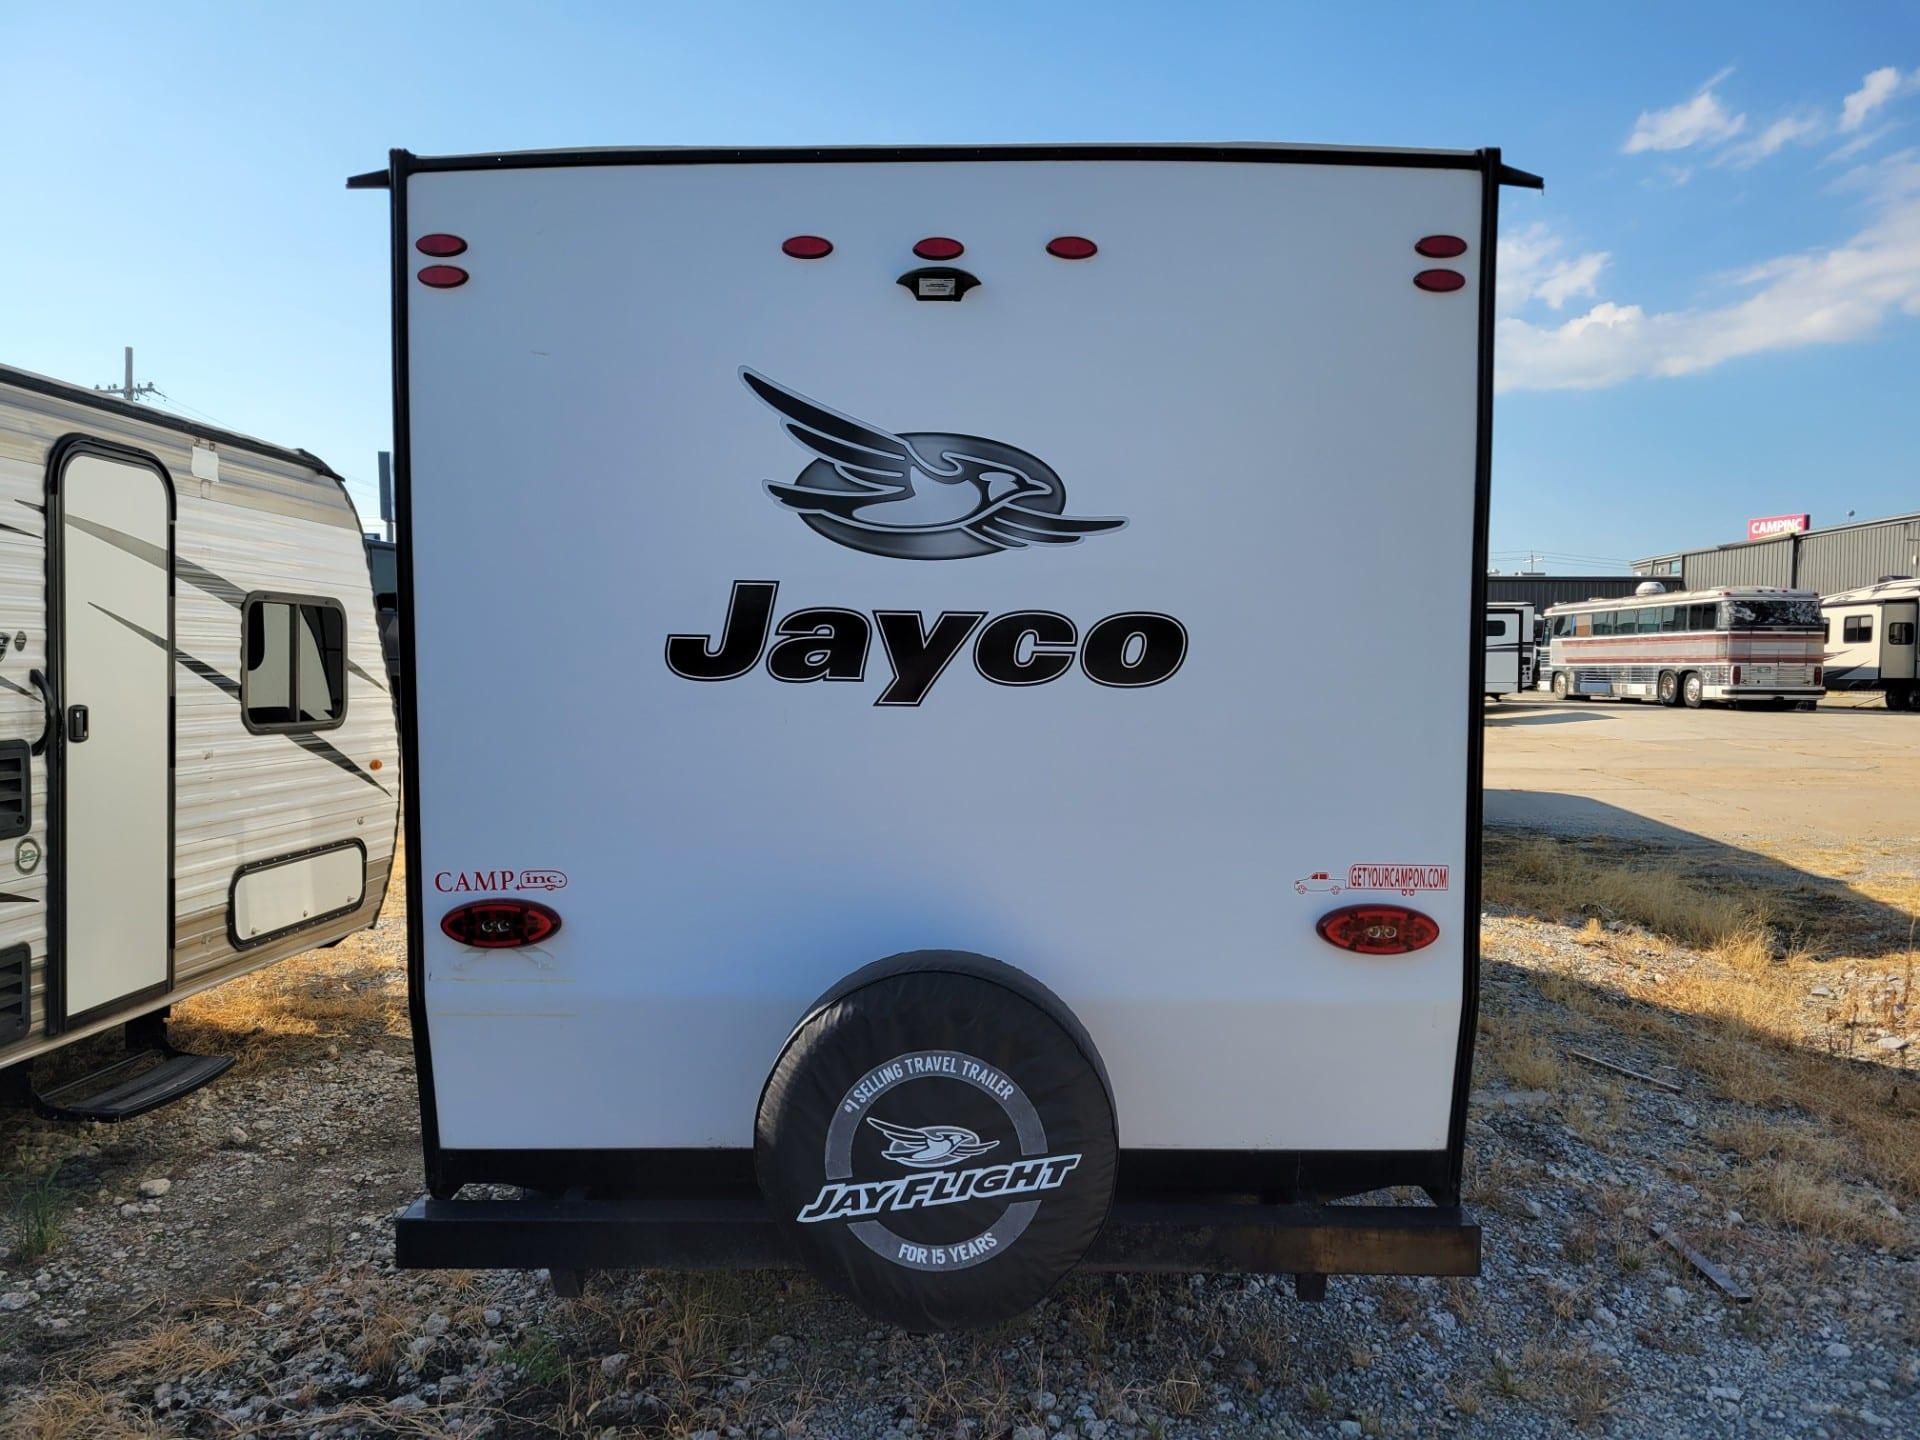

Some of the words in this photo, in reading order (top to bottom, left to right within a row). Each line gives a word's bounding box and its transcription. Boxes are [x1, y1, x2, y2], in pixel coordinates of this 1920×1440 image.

[665, 580, 1189, 706] Jayco
[435, 870, 514, 892] CAMP
[526, 873, 563, 884] inc.
[1351, 867, 1447, 888] GETYOURCAMPON.COM
[853, 1063, 903, 1103] SELLING
[905, 1056, 957, 1074] TRAVEL
[963, 1060, 1014, 1100] TRAILER
[898, 1243, 927, 1264] FOR
[931, 1249, 946, 1264] 15
[949, 1232, 997, 1262] YEARS
